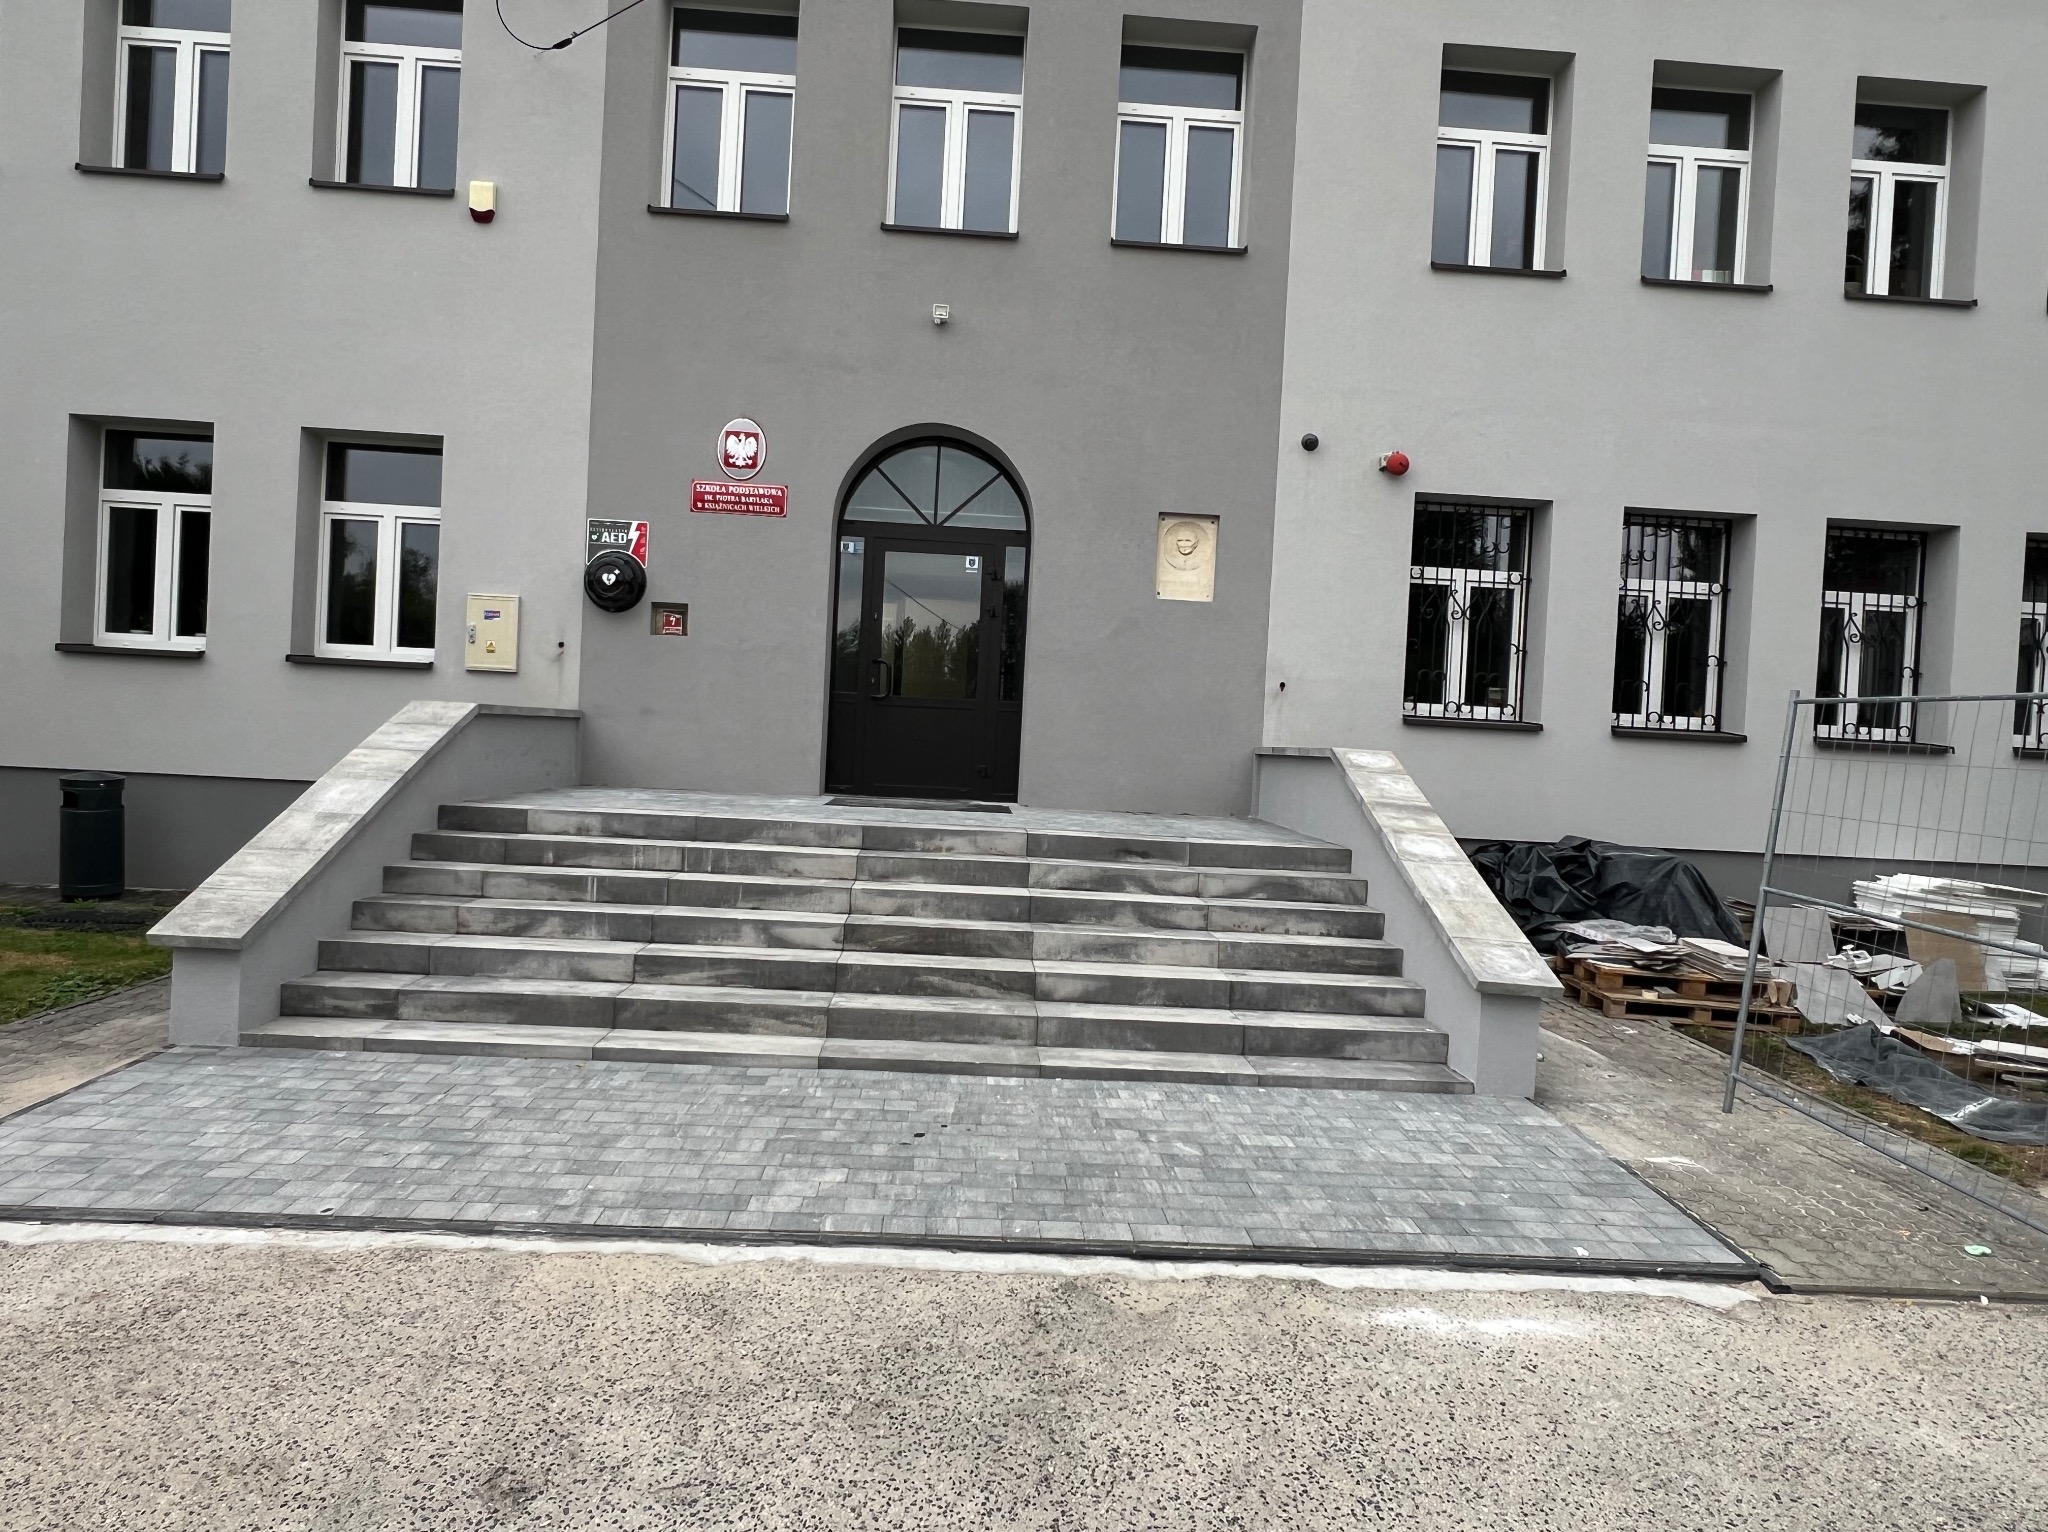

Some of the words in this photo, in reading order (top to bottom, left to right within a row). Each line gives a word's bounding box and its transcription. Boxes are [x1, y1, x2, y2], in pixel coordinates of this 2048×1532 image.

[696, 484, 726, 493] SZKOŁA
[728, 485, 782, 496] PODSTAWOWA
[601, 532, 627, 543] AED
